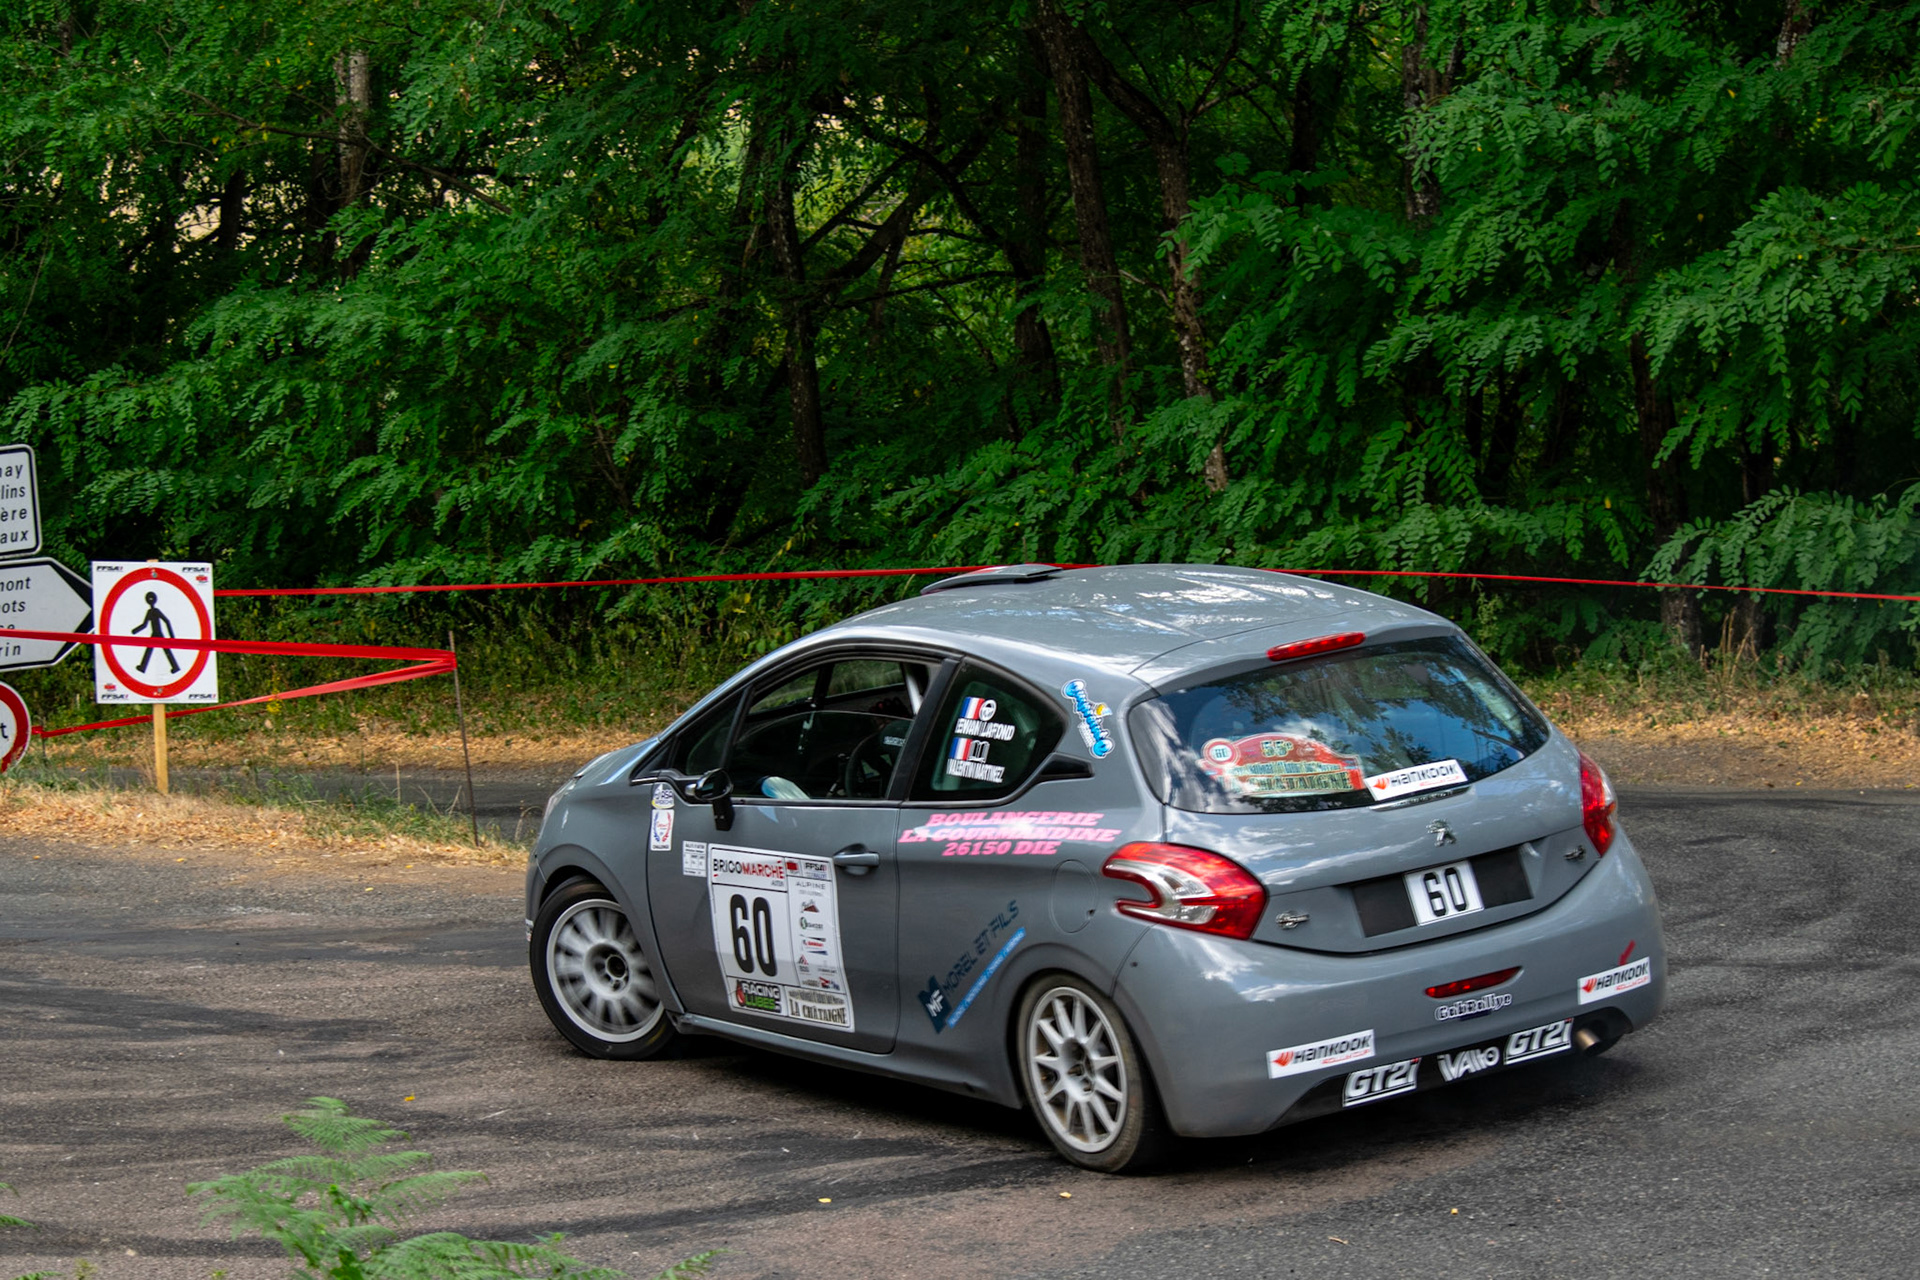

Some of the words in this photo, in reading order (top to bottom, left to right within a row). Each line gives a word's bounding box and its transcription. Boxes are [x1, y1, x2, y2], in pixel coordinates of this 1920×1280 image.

[0, 465, 23, 479] ay
[1, 485, 26, 499] lins
[0, 530, 29, 544] aux
[925, 811, 1104, 827] BOULANGERIE
[941, 841, 1012, 857] 26150
[1012, 840, 1062, 856] DIE
[1423, 867, 1468, 917] 60
[987, 899, 1019, 938] FILS
[730, 893, 778, 978] 60
[741, 982, 781, 999] RACING
